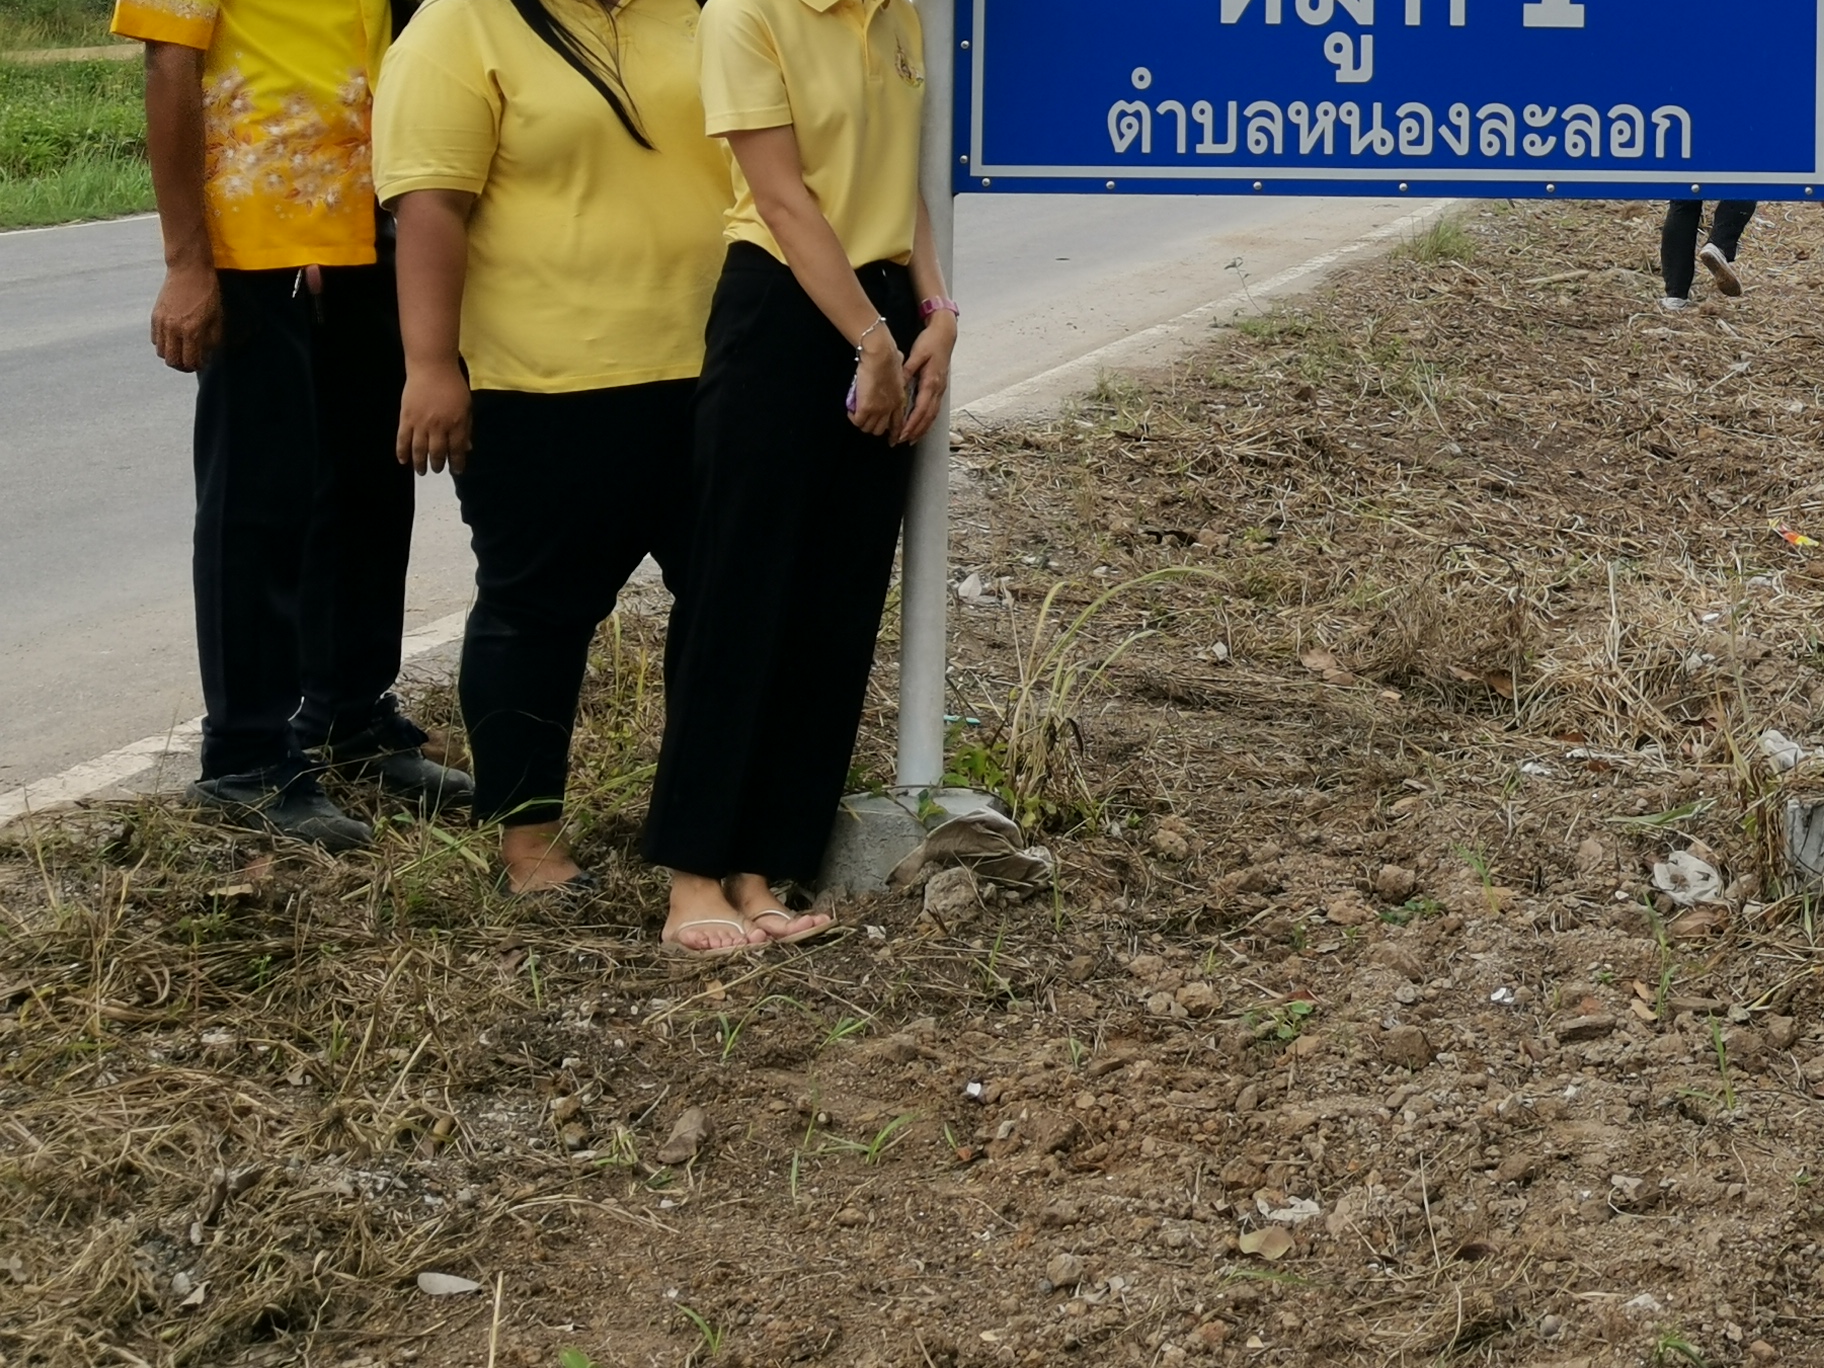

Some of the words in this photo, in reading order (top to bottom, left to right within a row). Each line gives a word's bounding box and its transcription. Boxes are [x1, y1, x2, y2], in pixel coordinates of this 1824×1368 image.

[1107, 66, 1692, 160] ตำบลหนองละลอก
